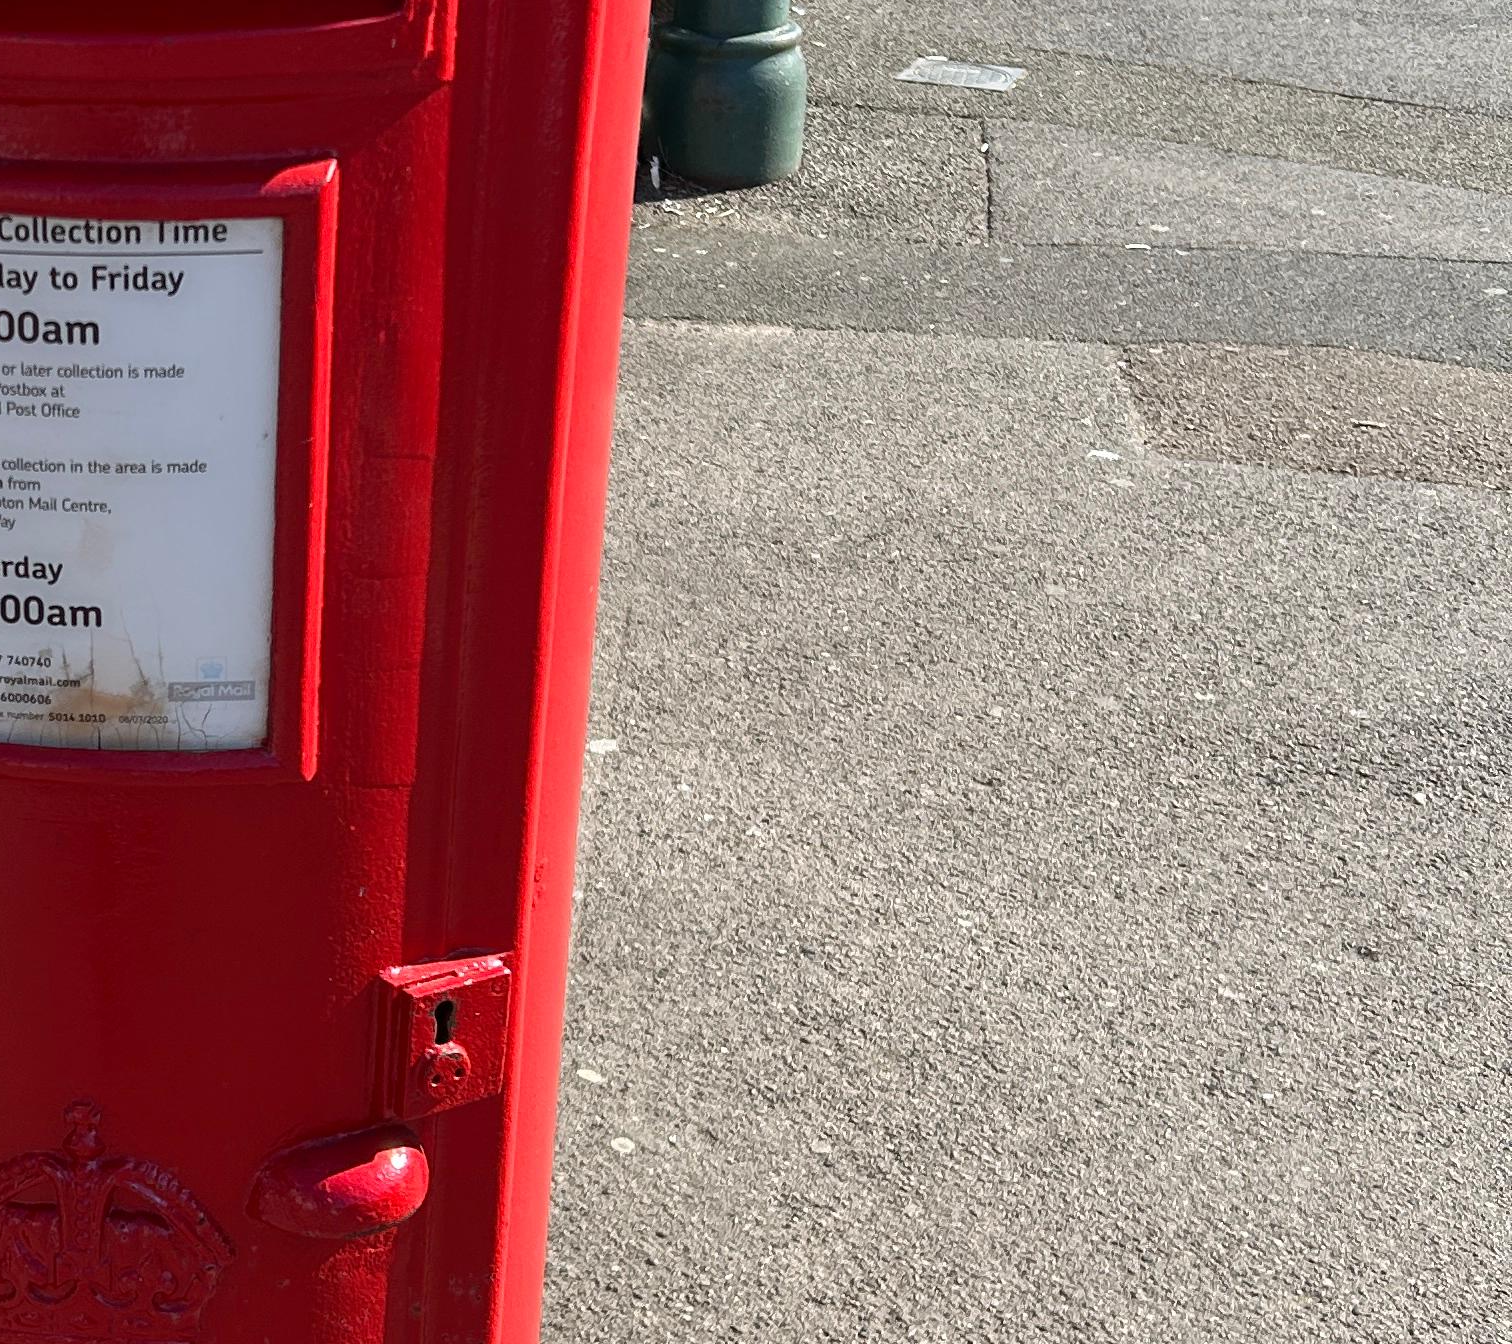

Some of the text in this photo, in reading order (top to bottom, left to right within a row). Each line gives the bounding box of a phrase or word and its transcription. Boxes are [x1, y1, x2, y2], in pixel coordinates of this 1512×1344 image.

[49, 266, 78, 291] to
[91, 264, 185, 297] Friday
[1, 364, 16, 377] or
[20, 361, 52, 378] later
[57, 363, 124, 380] collection
[127, 364, 139, 379] is
[143, 362, 185, 379] made
[51, 384, 65, 398] at
[6, 401, 38, 417] Post
[40, 402, 81, 419] Office
[1, 457, 66, 474] collection
[69, 459, 83, 474] in
[87, 459, 111, 474] the
[114, 462, 147, 475] area
[151, 459, 163, 474] is
[166, 459, 208, 474] made
[7, 476, 42, 492] from
[29, 496, 58, 511] Mail
[61, 497, 112, 514] Centre,
[7, 654, 52, 668] 740740
[0, 692, 52, 705] 6000606
[173, 683, 251, 698] Royal Mail
[7, 710, 44, 721] number
